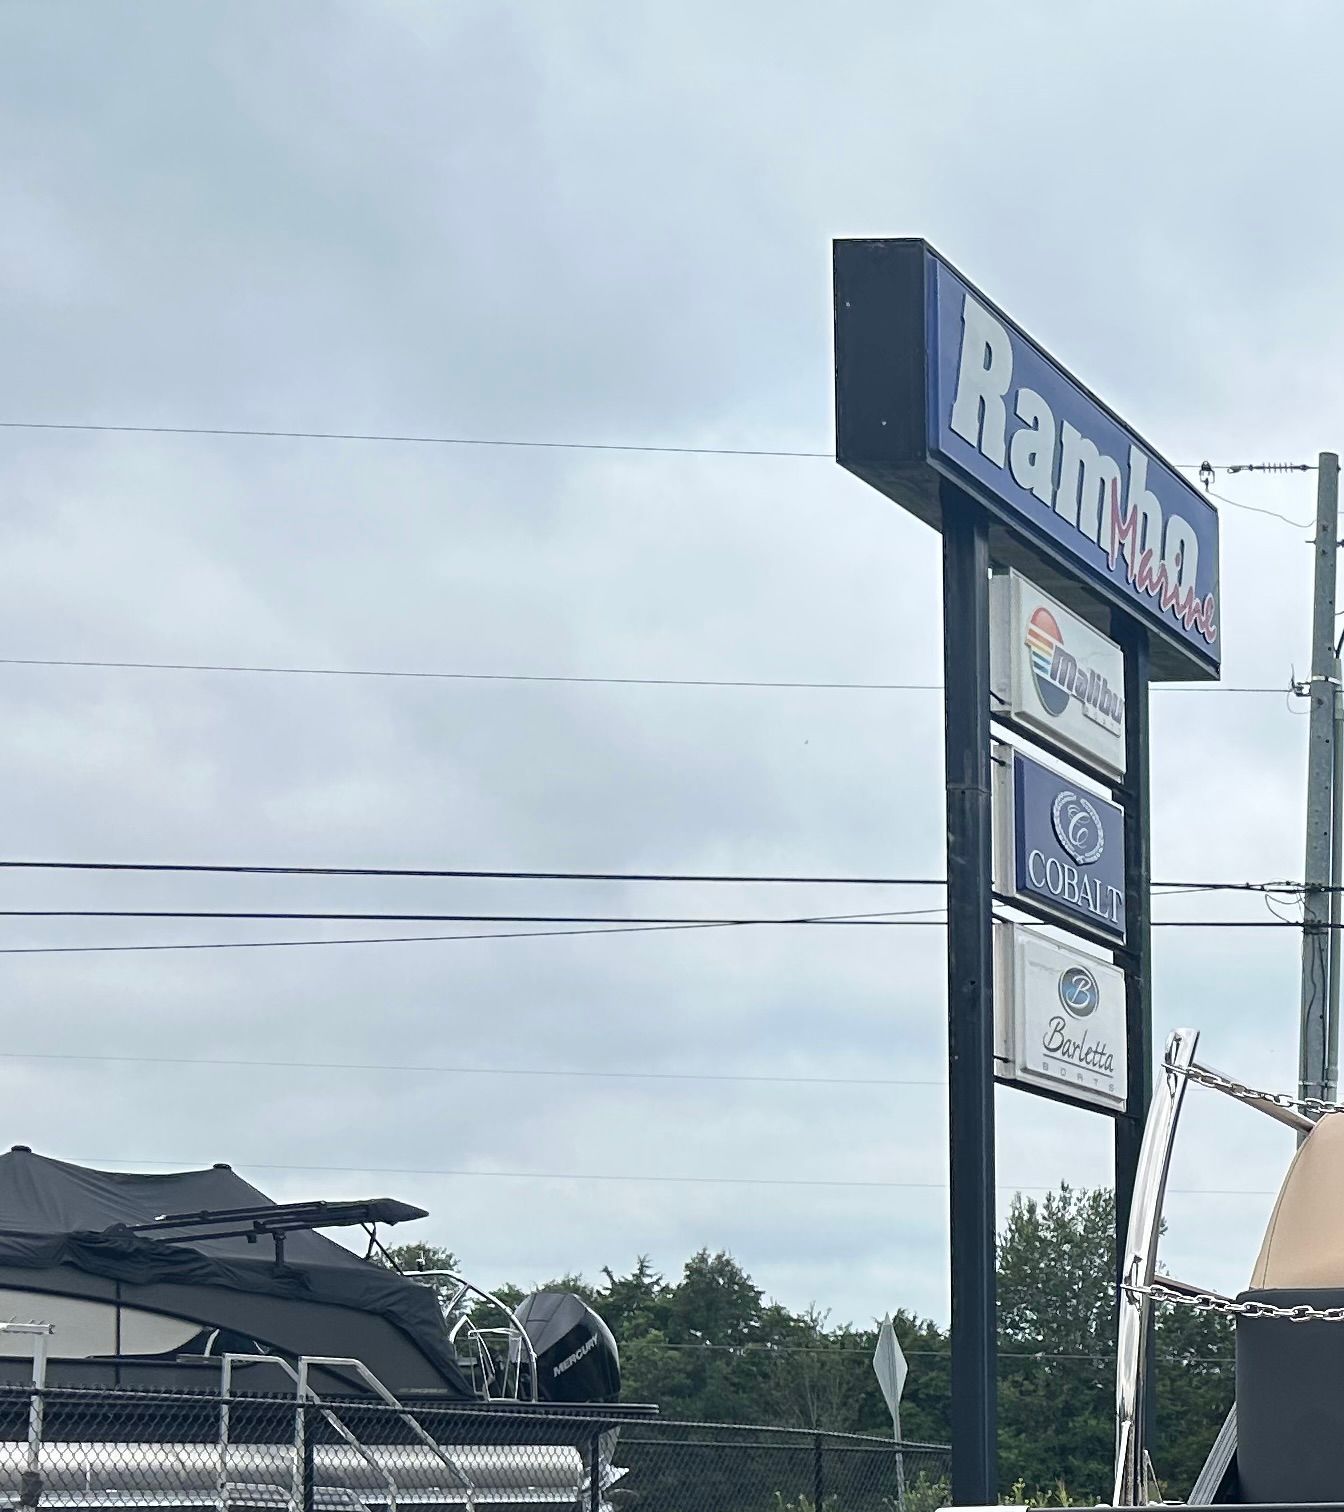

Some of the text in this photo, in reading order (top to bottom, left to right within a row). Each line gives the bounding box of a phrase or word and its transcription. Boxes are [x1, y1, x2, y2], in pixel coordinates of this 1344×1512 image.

[1108, 475, 1217, 645] Marine
[1028, 850, 1122, 923] COBALT
[1043, 1015, 1114, 1072] Barletta
[553, 1333, 598, 1378] MERCURY
